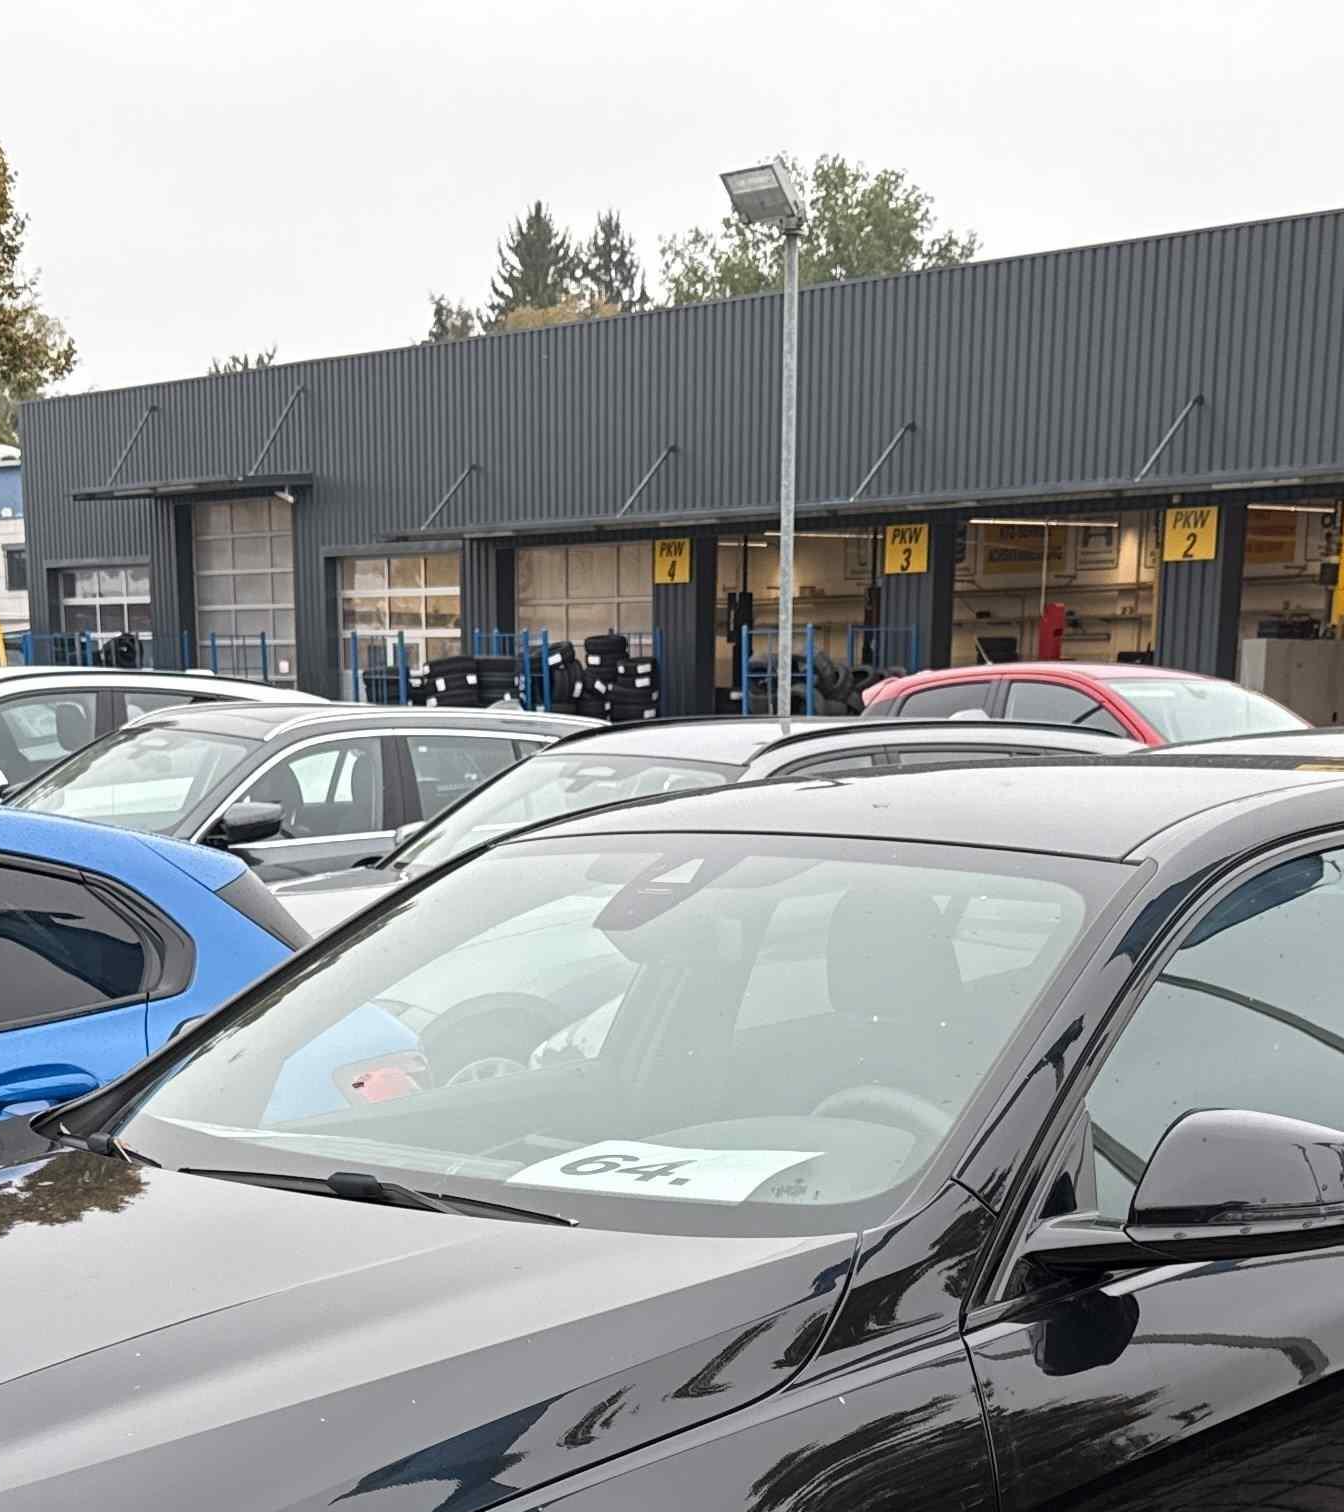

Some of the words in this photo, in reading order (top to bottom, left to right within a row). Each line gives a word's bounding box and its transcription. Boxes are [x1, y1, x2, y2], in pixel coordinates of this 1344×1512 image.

[1172, 510, 1211, 530] PKW
[891, 527, 922, 546] PKW
[1182, 532, 1197, 559] 2
[659, 540, 684, 557] PKW
[900, 547, 912, 572] 3
[667, 560, 677, 582] 4
[559, 1154, 698, 1187] 64.
